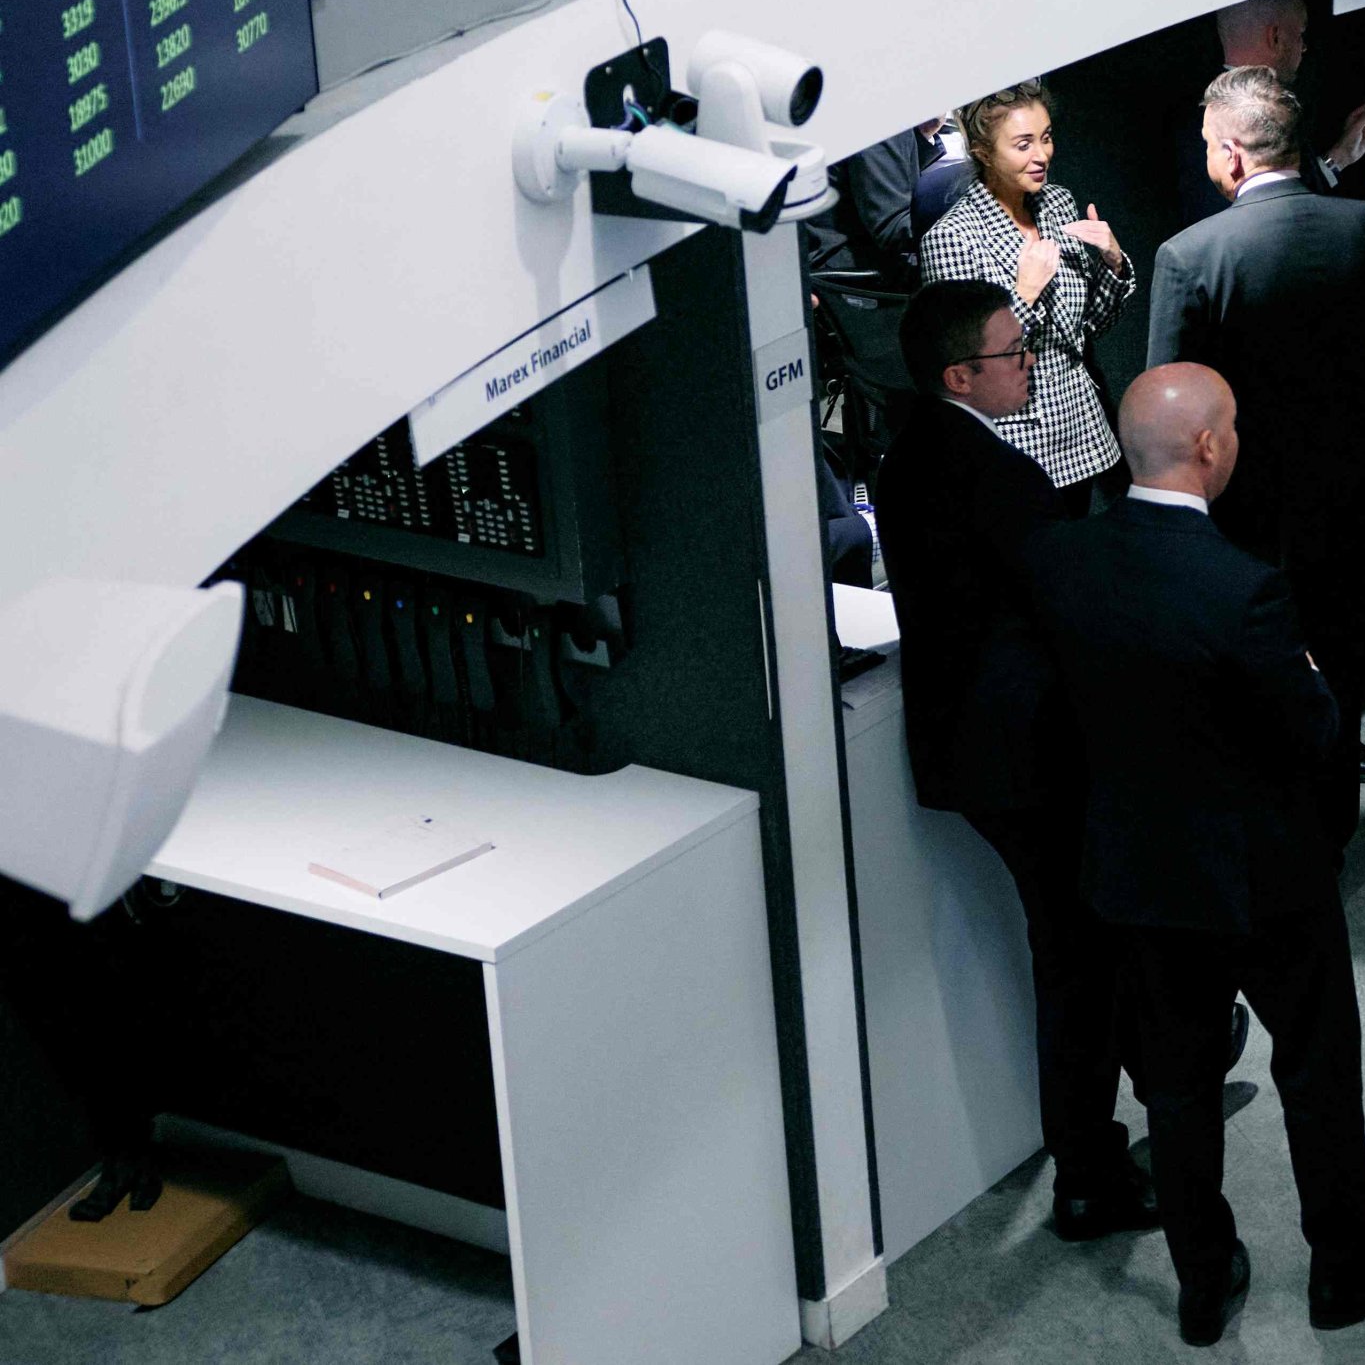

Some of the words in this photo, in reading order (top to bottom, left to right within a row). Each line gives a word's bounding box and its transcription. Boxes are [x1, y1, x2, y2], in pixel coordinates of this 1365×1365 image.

[485, 364, 530, 402] Marex
[530, 318, 592, 374] Financial
[766, 358, 804, 391] GFM
